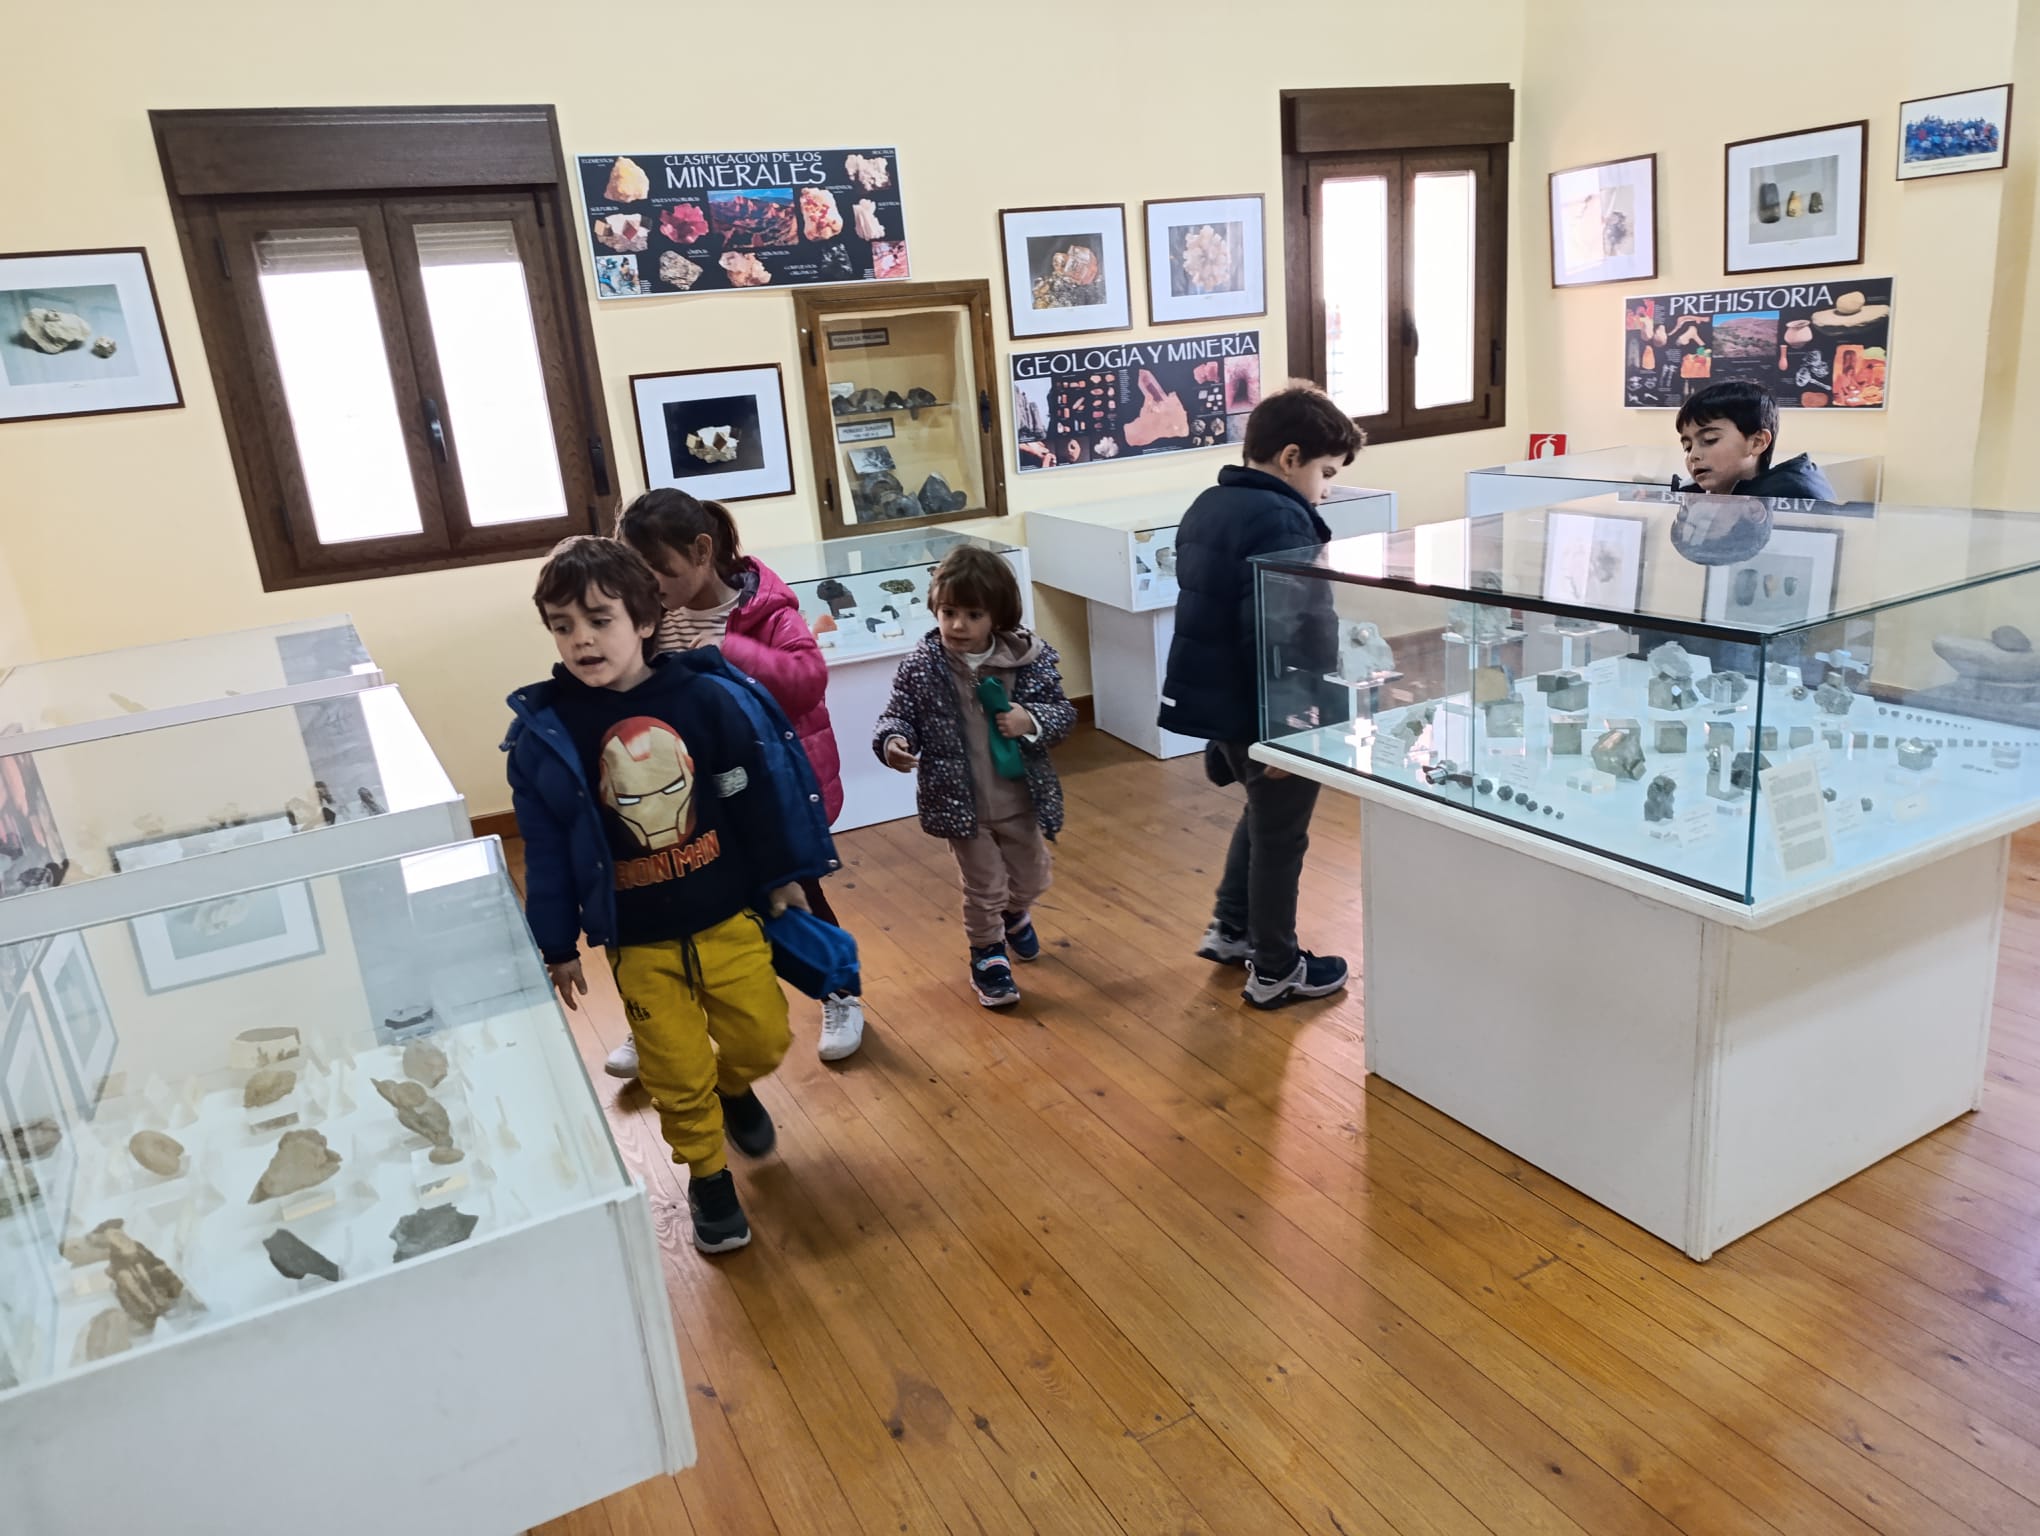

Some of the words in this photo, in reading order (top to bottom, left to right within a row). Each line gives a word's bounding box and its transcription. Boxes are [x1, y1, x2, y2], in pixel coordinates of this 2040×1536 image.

[664, 151, 769, 166] CLASIFICACIÓN
[772, 152, 792, 163] DE
[796, 152, 822, 163] LOS
[665, 162, 827, 189] MINERALES
[1669, 285, 1834, 316] PREHISTORIA
[1016, 344, 1145, 378] GEOLOGÍA
[1148, 345, 1163, 364] Y
[1168, 333, 1257, 362] MINERÍA
[671, 830, 720, 877] MAN
